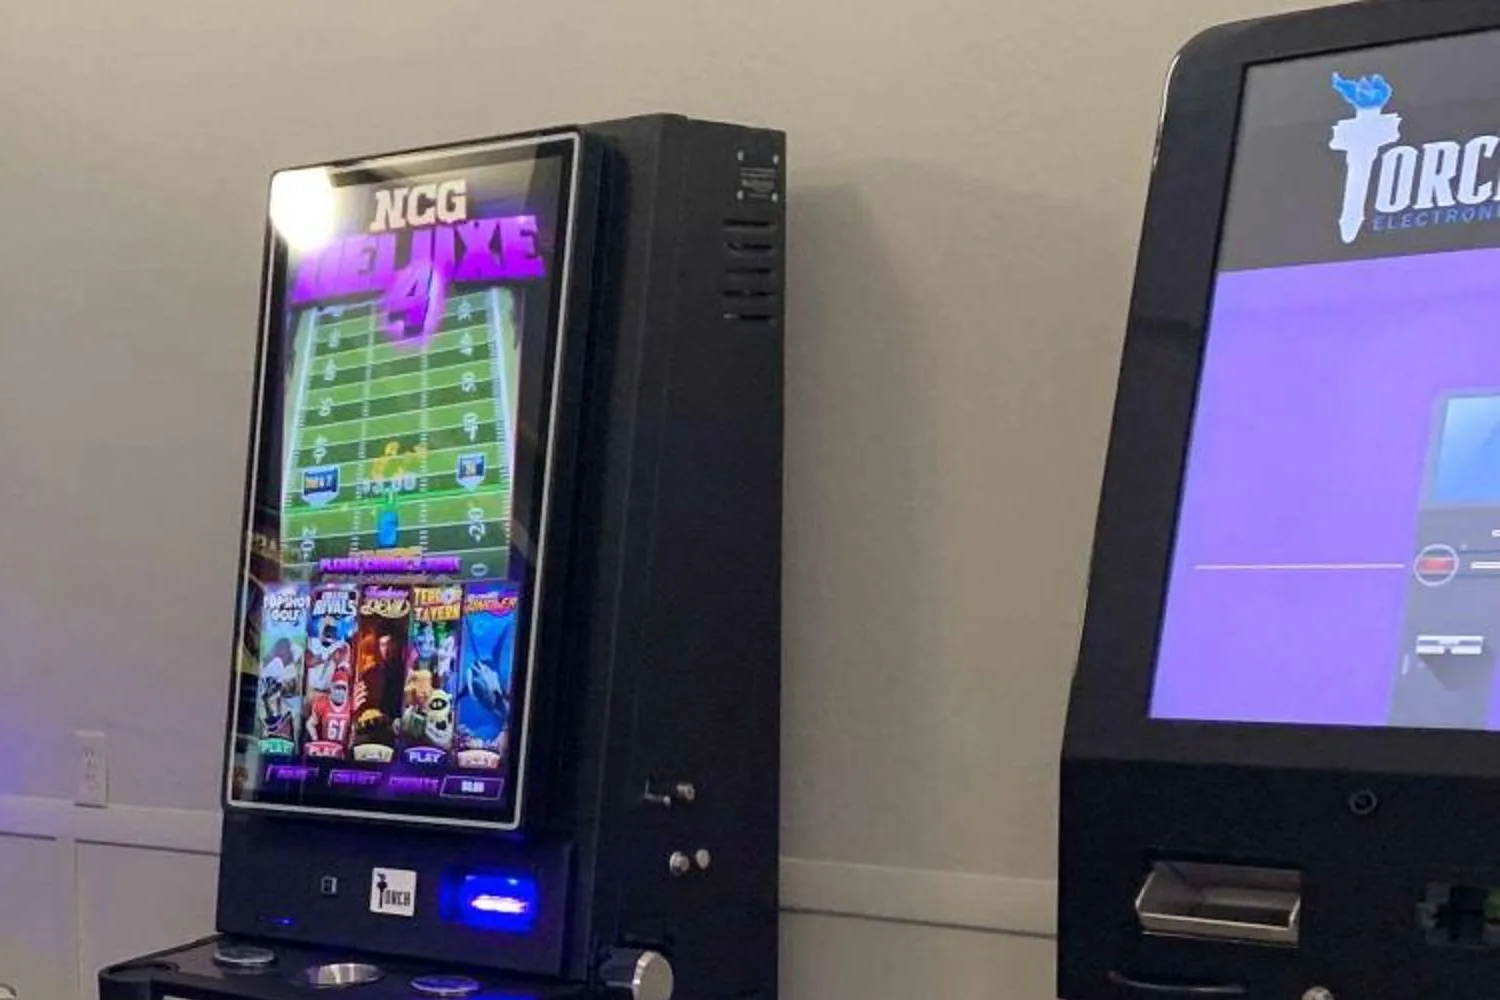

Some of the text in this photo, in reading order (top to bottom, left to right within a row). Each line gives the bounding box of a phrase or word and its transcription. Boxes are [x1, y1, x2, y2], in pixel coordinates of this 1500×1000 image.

[370, 179, 468, 232] NCG
[1329, 106, 1500, 243] TORC
[387, 256, 435, 337] 4
[409, 751, 440, 764] PLAY
